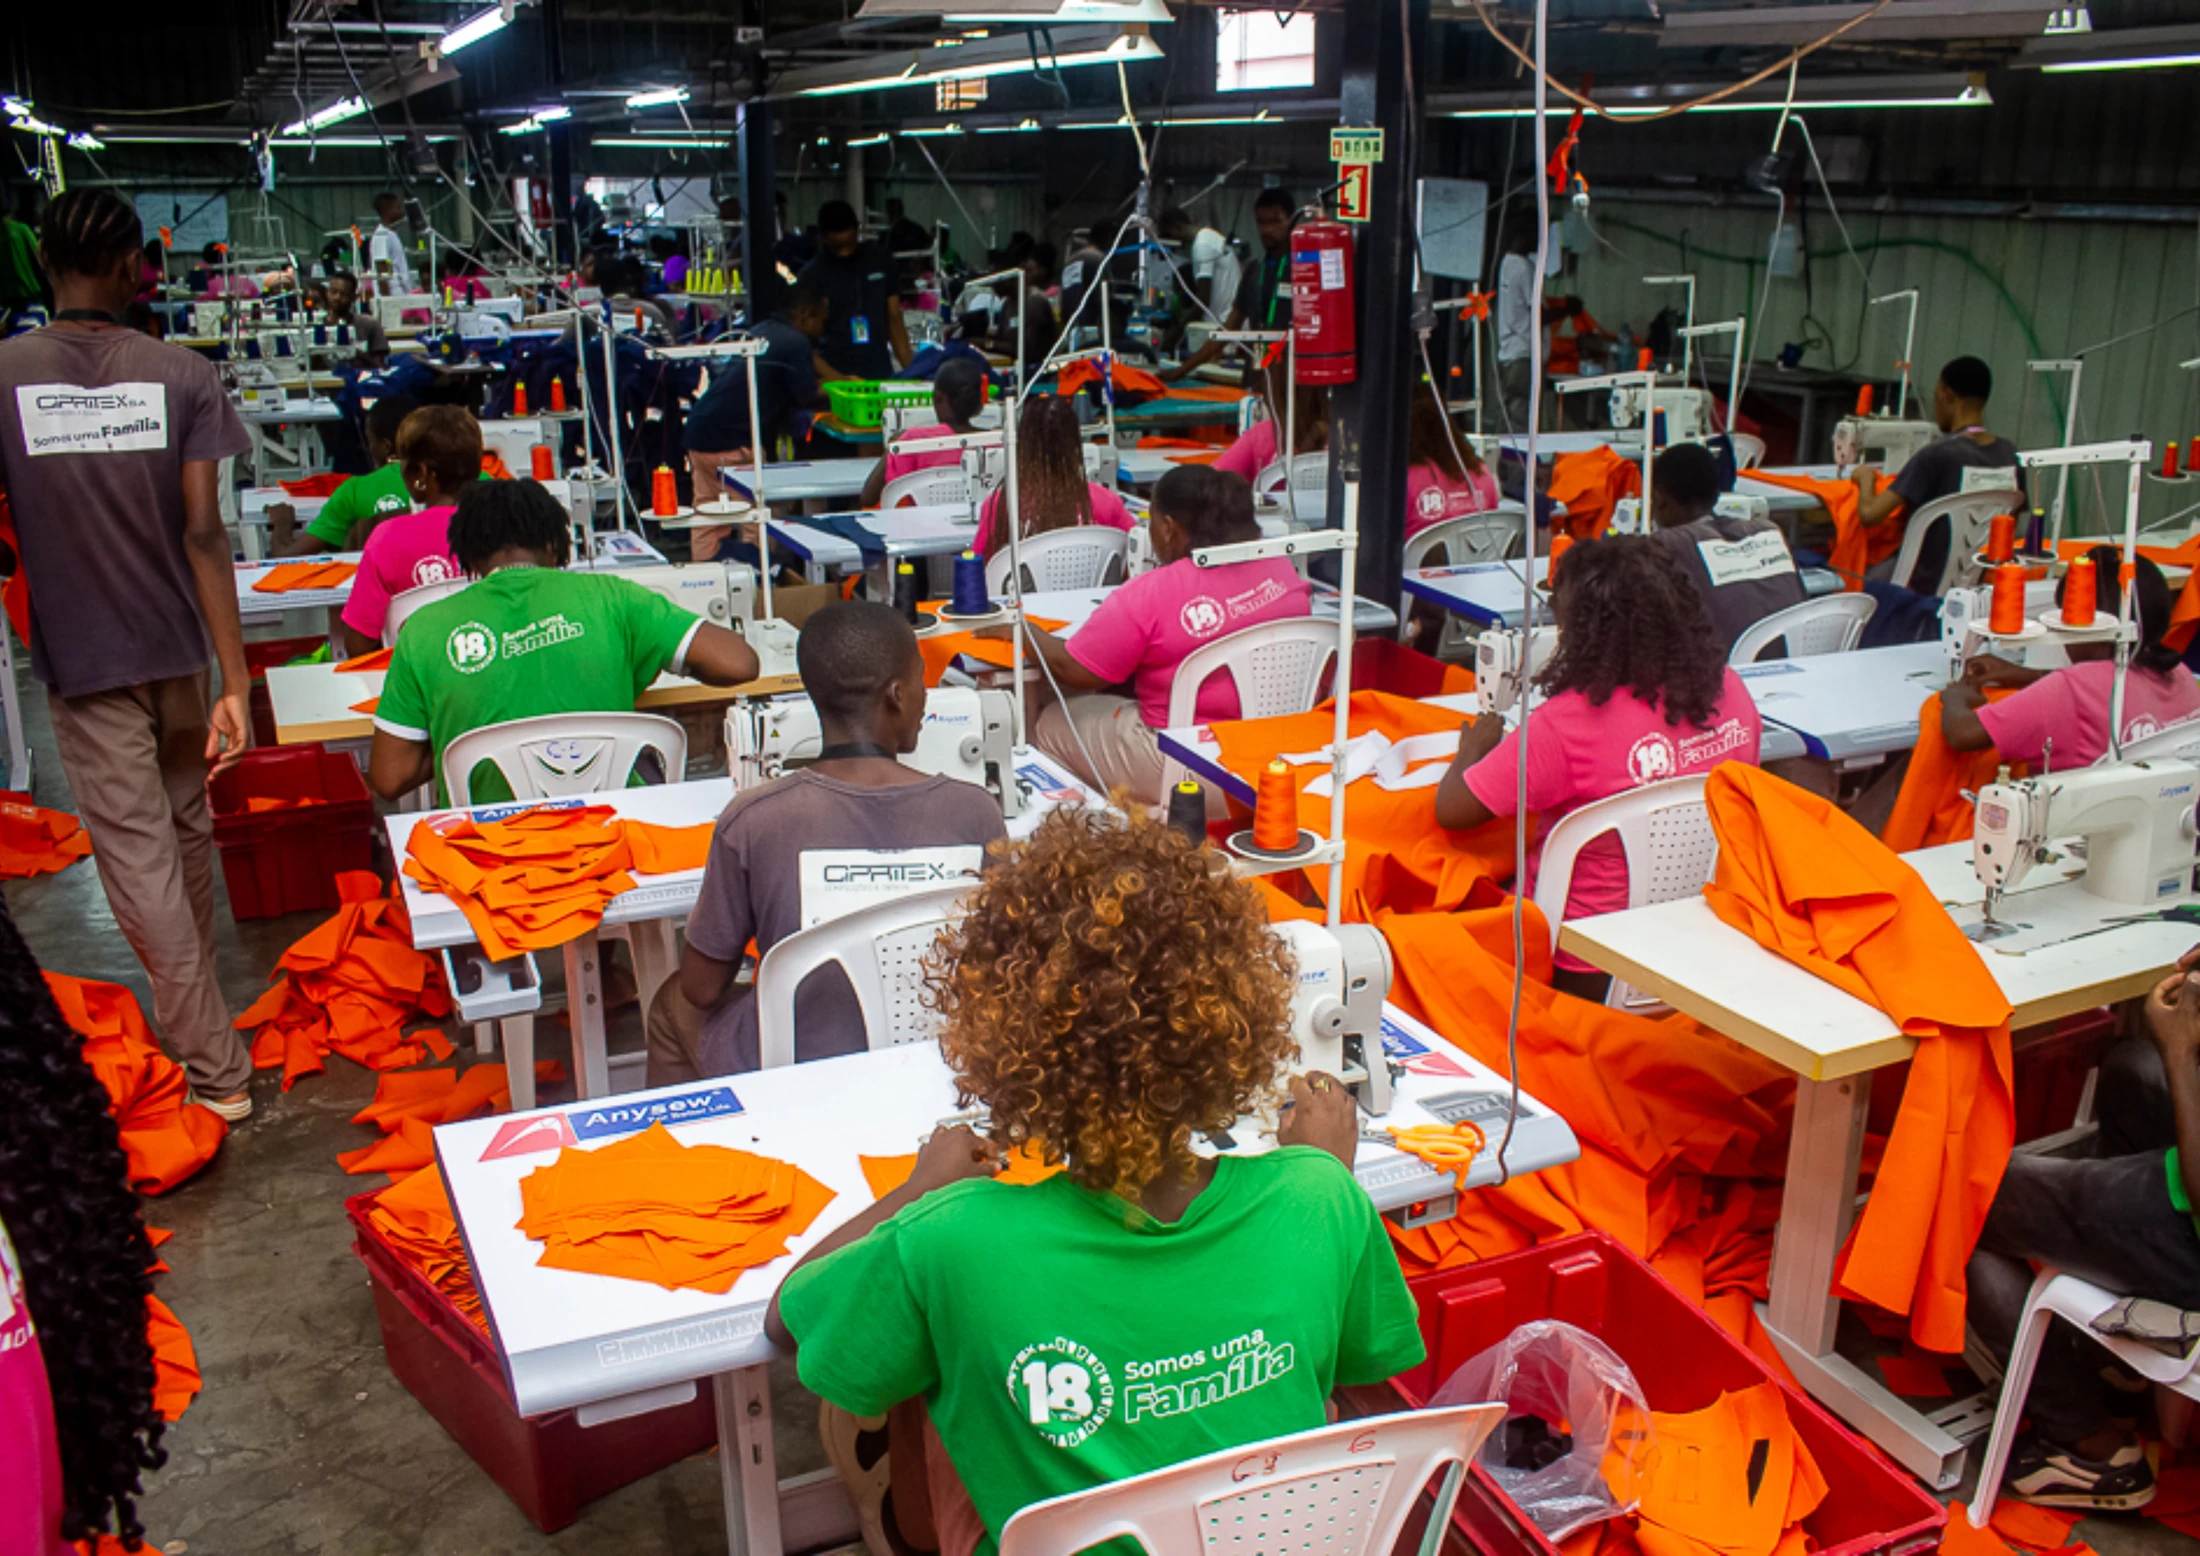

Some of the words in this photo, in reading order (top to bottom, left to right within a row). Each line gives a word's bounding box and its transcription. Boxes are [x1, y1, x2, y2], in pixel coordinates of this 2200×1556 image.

[101, 417, 160, 437] Família
[418, 563, 445, 586] 18
[1186, 603, 1217, 630] 18
[453, 632, 487, 663] 18
[1636, 742, 1669, 778] 18
[585, 1095, 713, 1128] Anysew
[1124, 1350, 1206, 1380] Somos
[1211, 1328, 1264, 1360] uma
[1022, 1361, 1094, 1425] 18
[1123, 1340, 1295, 1424] Família
